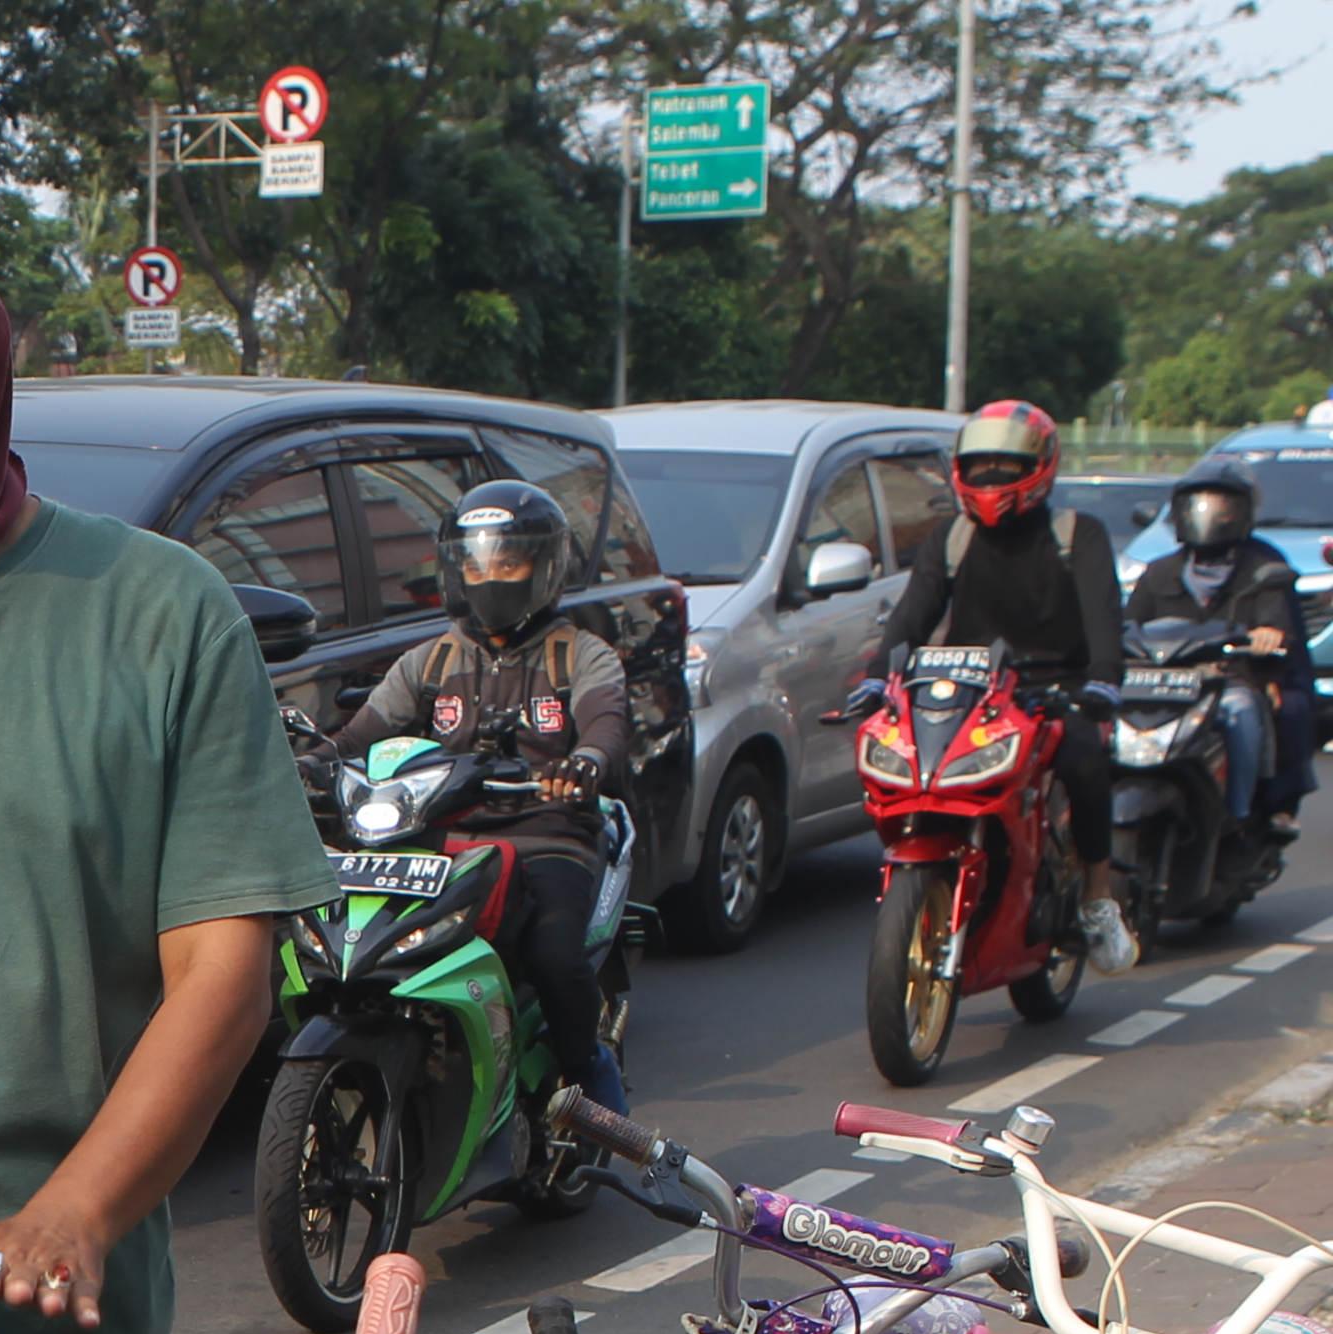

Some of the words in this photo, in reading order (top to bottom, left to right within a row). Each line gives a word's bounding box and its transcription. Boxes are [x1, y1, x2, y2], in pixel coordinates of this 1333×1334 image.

[652, 122, 721, 143] Salemba
[650, 161, 699, 181] Tebet
[649, 189, 720, 208] Pancoran
[341, 857, 399, 874] 6177
[407, 858, 441, 877] NM
[784, 1204, 930, 1274] Glamour
